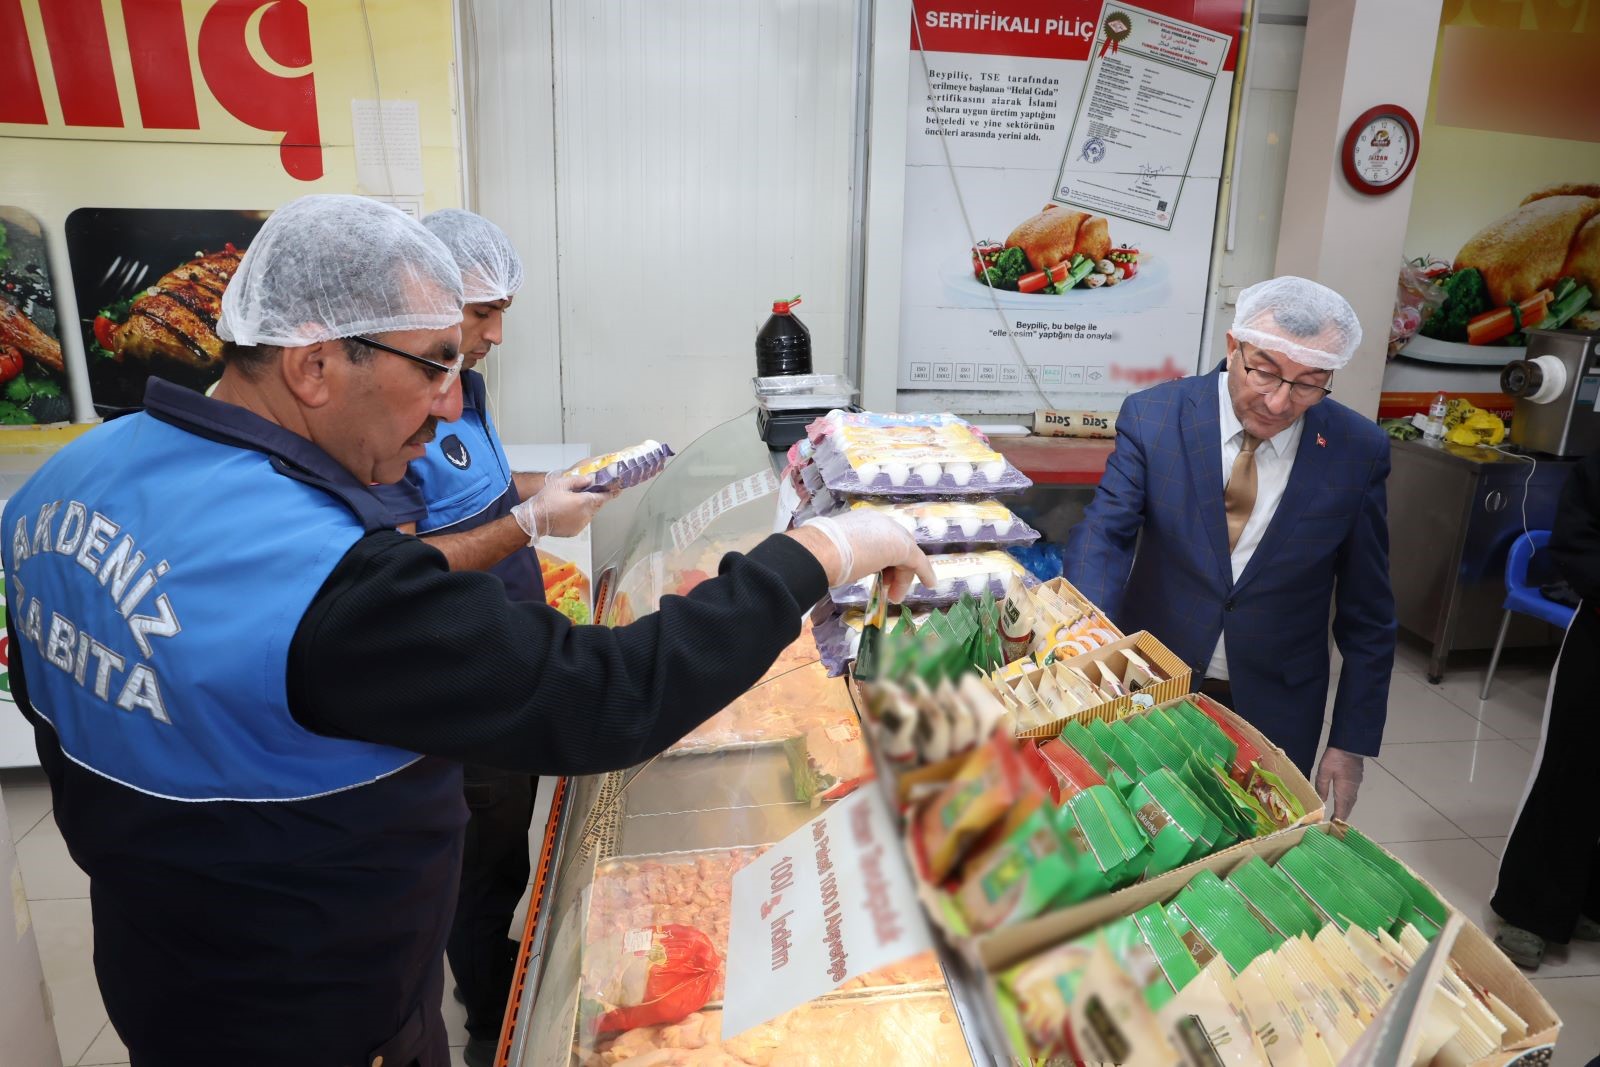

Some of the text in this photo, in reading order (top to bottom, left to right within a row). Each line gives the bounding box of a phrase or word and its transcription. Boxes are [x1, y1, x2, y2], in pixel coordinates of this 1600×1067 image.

[925, 9, 1094, 42] SERTİFİKALI PİLİÇ
[929, 69, 1059, 85] Beypiliç, TSE tarafından
[969, 82, 1005, 93] başlanan
[991, 97, 1022, 106] alarak
[1028, 96, 1057, 108] İslami
[962, 107, 988, 117] uygun
[990, 106, 1018, 117] üretim
[1020, 110, 1056, 120] yaptığını
[983, 119, 1002, 128] yine
[1006, 121, 1055, 131] sektörünün
[960, 129, 996, 139] arasında
[998, 131, 1022, 141] yerini
[1023, 132, 1041, 141] aldı.
[1016, 321, 1097, 332] Beypiliç, bu belge ile
[1038, 330, 1073, 340] yaptığını
[1074, 331, 1085, 339] da
[1086, 331, 1115, 341] onayla
[13, 499, 183, 660] AKDENİZ
[12, 573, 173, 725] ZABITA
[820, 872, 838, 906] 1000
[823, 912, 849, 982] Alışverişe
